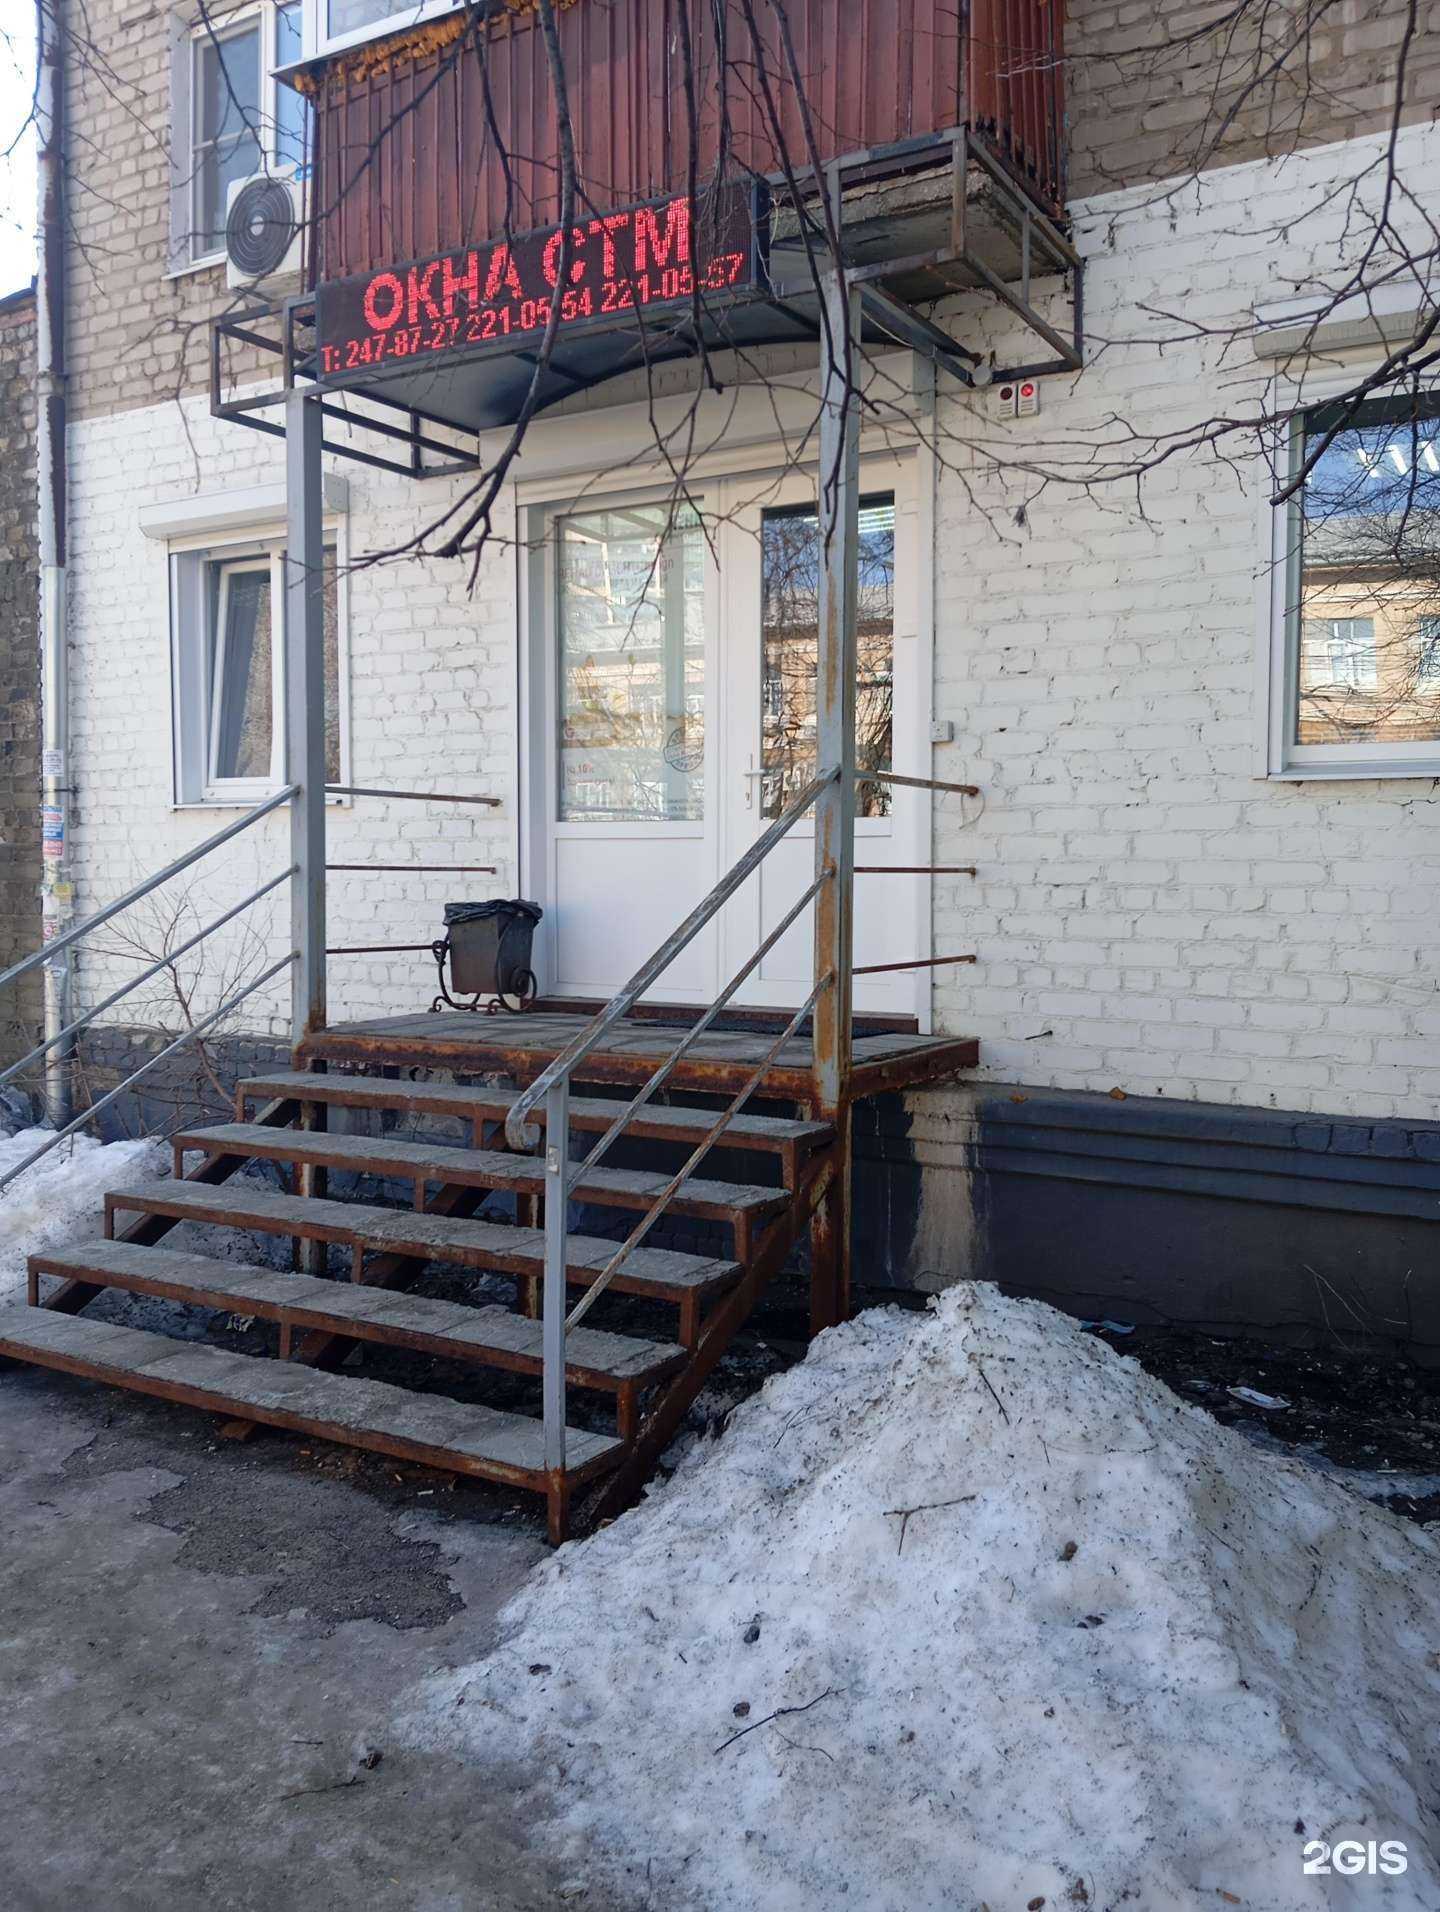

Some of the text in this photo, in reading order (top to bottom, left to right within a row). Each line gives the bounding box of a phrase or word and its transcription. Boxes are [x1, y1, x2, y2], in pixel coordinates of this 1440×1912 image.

[364, 197, 689, 332] ОКНА СТМ
[346, 317, 460, 368] 247-87-27
